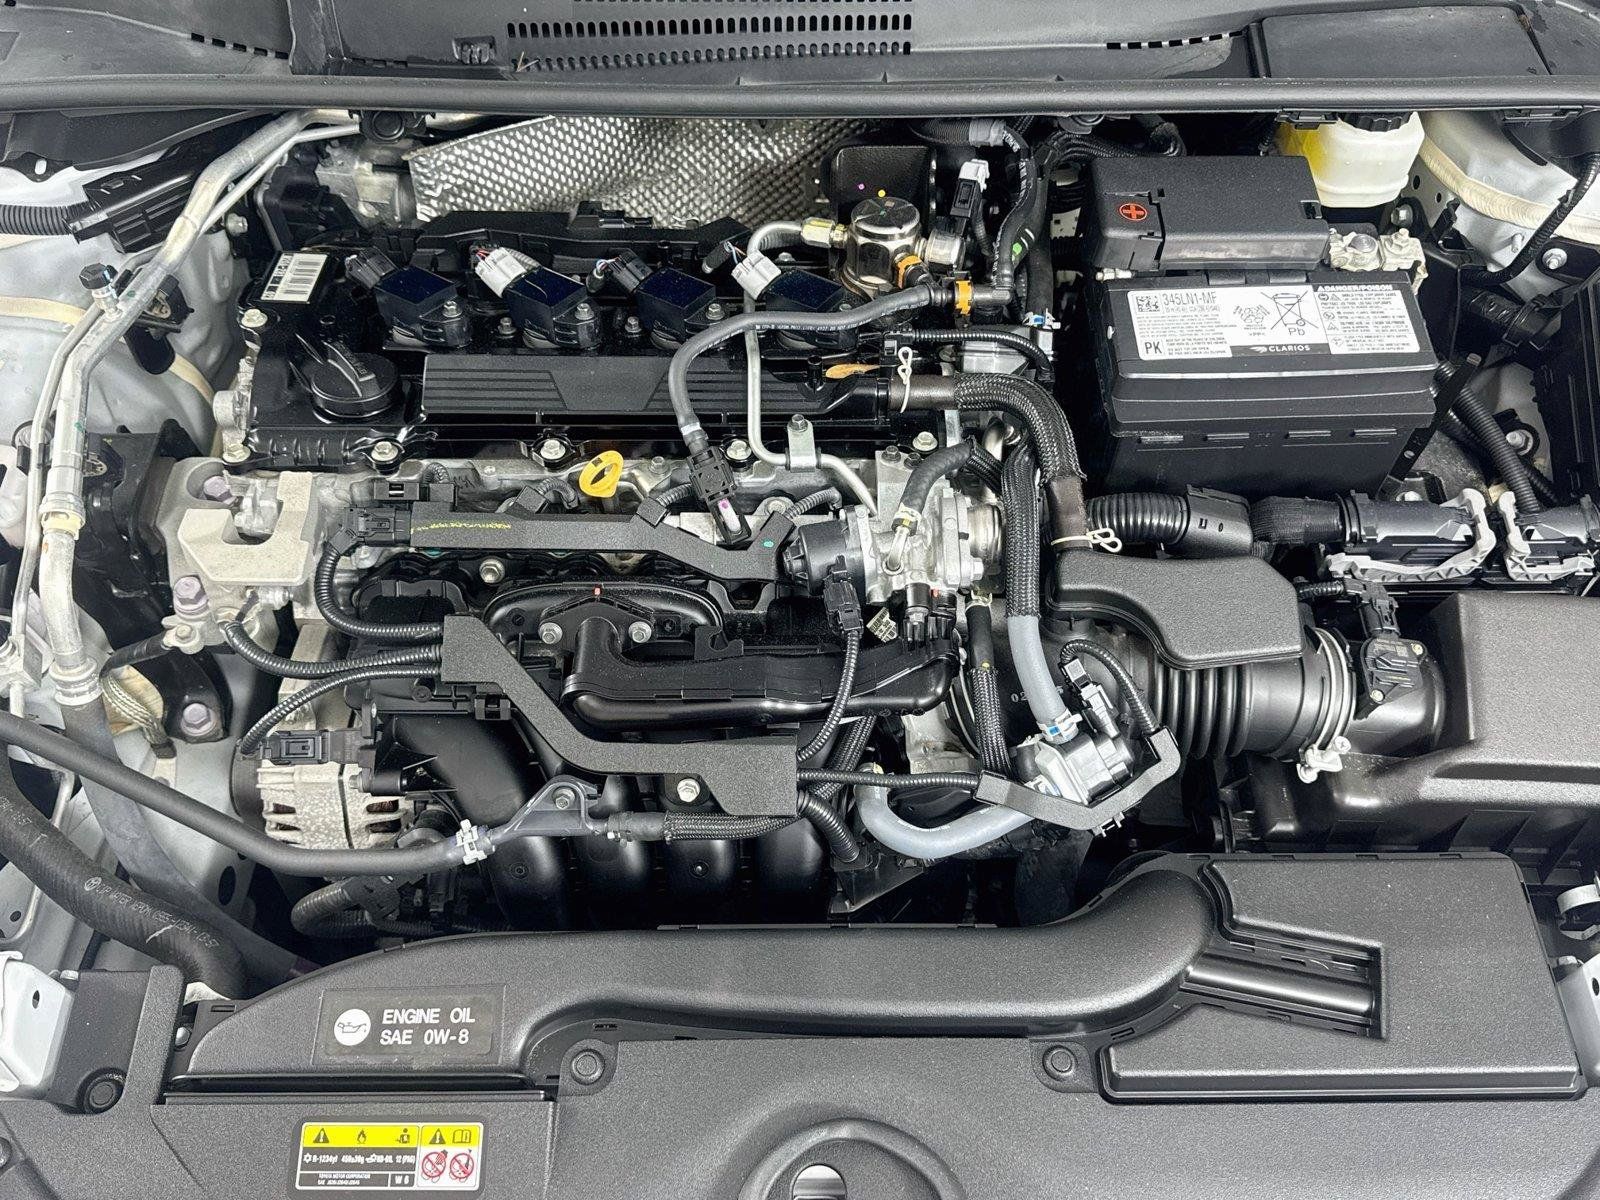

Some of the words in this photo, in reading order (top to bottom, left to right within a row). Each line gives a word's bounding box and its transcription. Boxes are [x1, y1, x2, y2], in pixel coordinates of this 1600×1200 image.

[1162, 291, 1217, 306] 345LN1-MF
[1288, 327, 1305, 336] Pb
[1144, 341, 1162, 355] PK
[1268, 344, 1311, 353] CLARIOS
[382, 1008, 440, 1024] ENGINE
[450, 1007, 476, 1023] OIL
[379, 1029, 413, 1045] SAE
[423, 1029, 469, 1045] 0W-8
[395, 1175, 403, 1184] W
